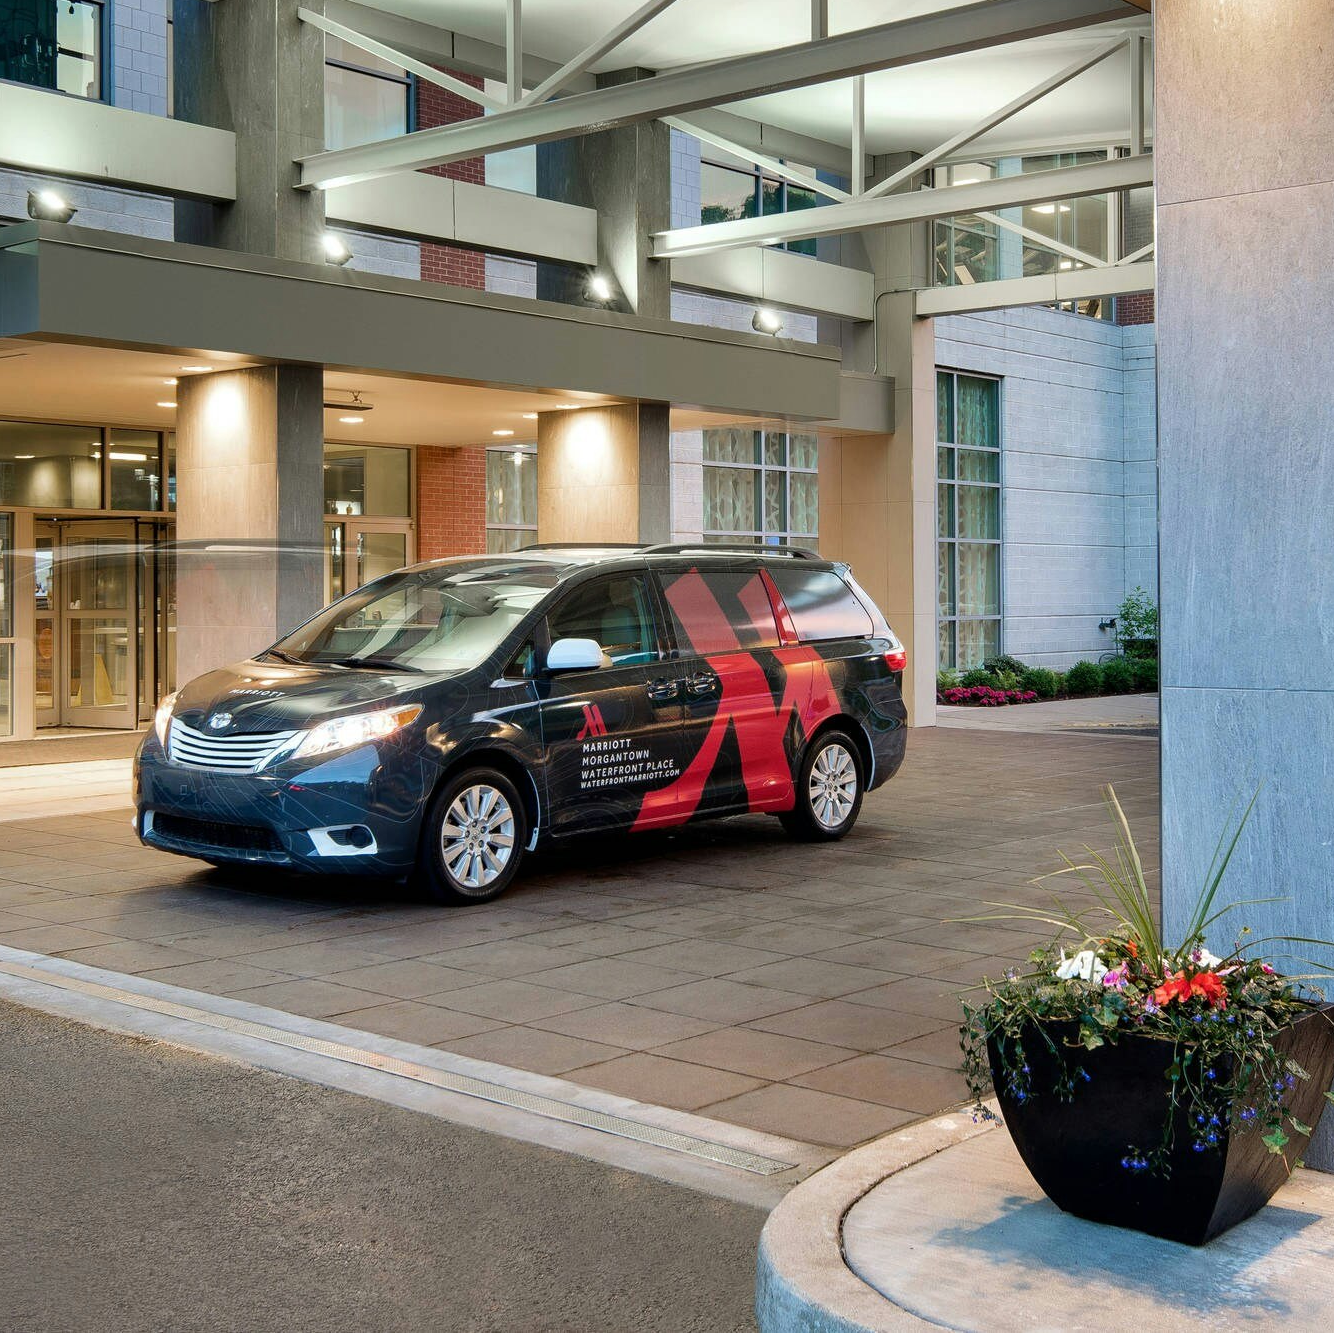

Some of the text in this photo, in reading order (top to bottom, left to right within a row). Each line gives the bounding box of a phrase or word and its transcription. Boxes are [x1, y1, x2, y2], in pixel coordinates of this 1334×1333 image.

[228, 688, 286, 697] MARRIOTT
[582, 738, 632, 753] MARRIOTT
[582, 750, 650, 766] MORGANTOWN
[581, 759, 674, 780] WATERFRONT PLACE
[580, 769, 680, 789] WATERFRONTMARRIOTT.COM
